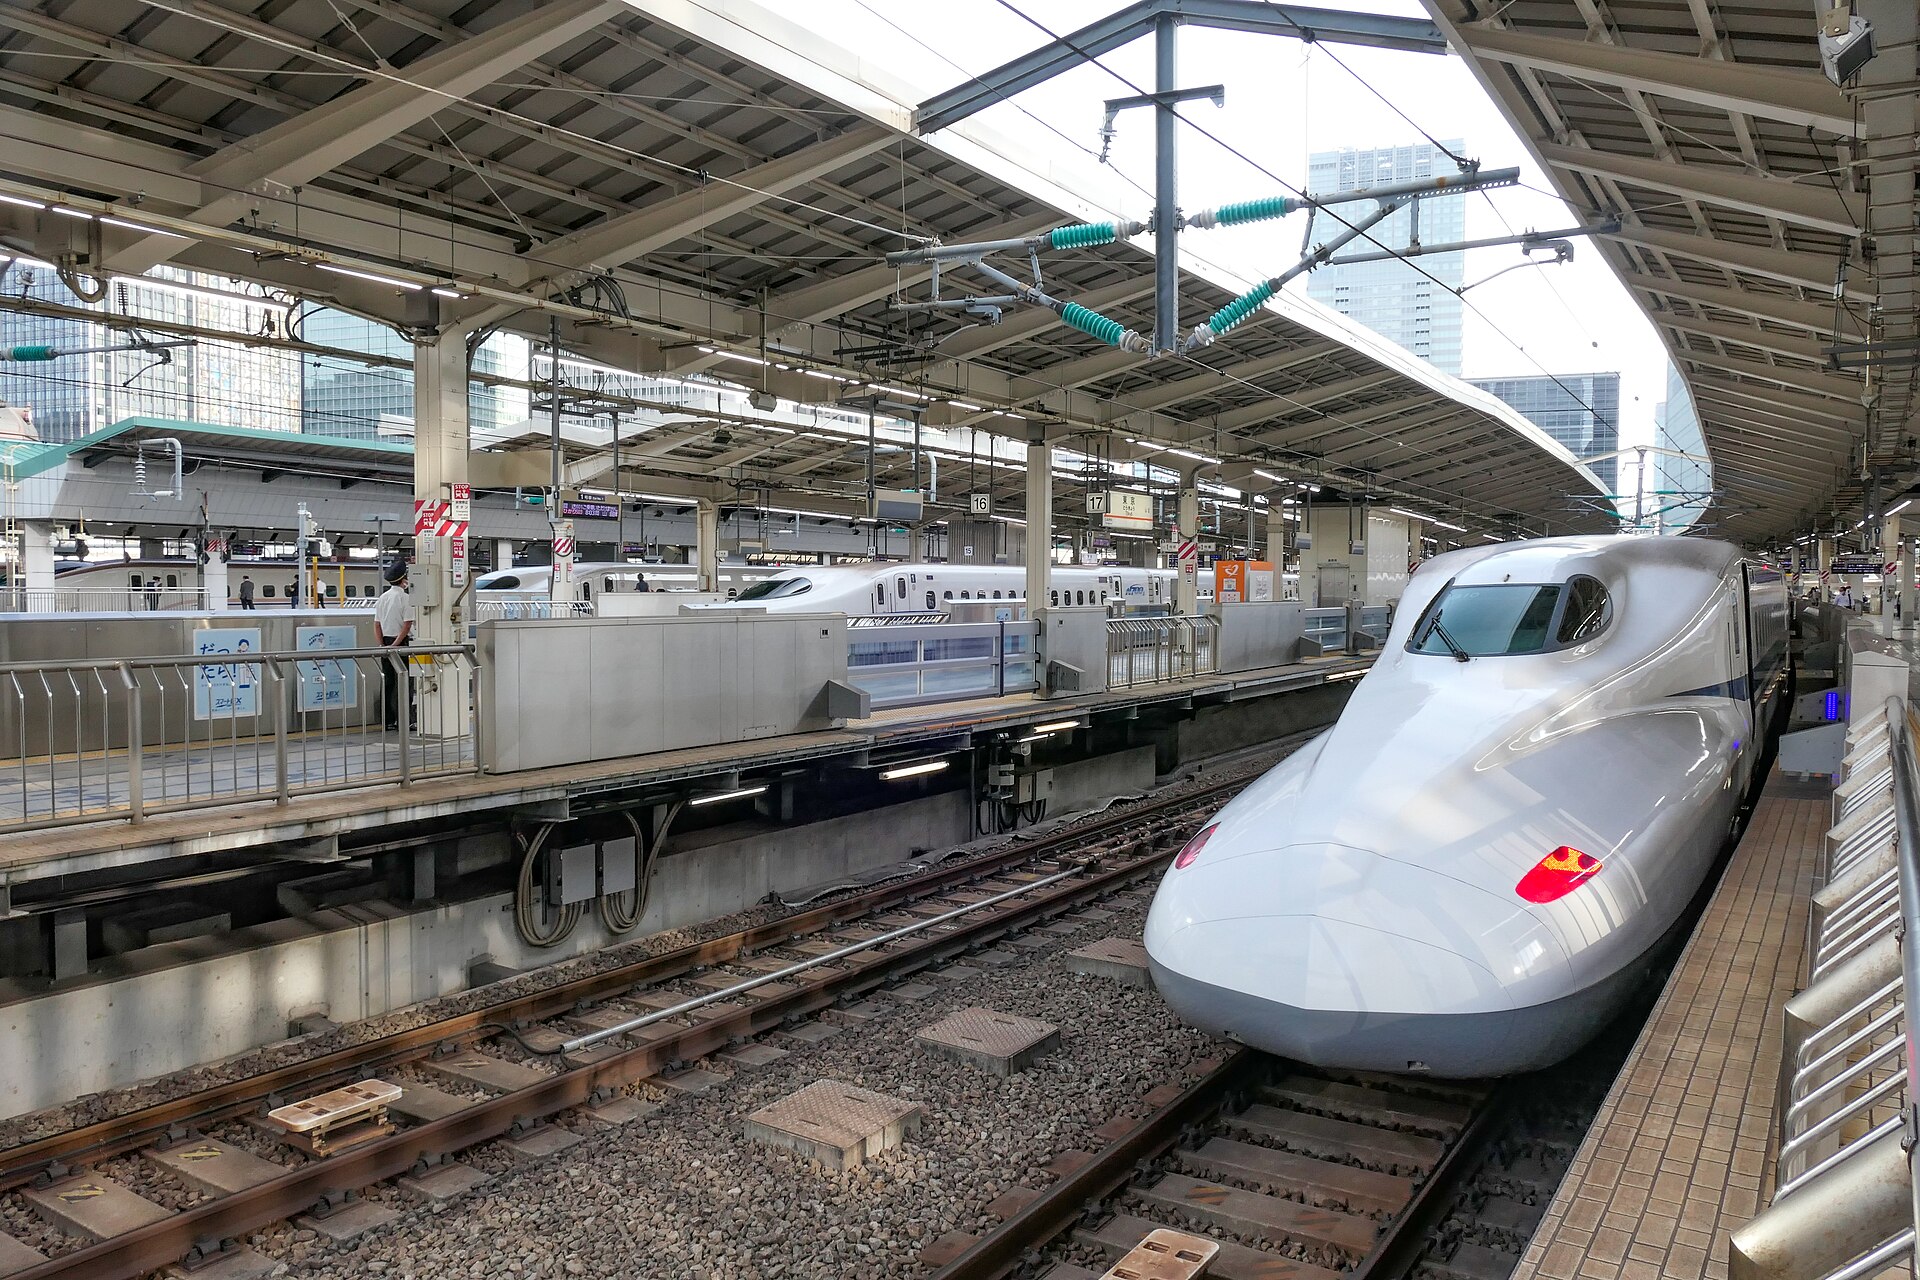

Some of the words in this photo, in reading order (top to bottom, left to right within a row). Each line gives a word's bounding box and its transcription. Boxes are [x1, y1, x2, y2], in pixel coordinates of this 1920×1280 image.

[974, 497, 987, 510] 16
[1089, 496, 1103, 510] 17
[965, 547, 972, 555] 15
